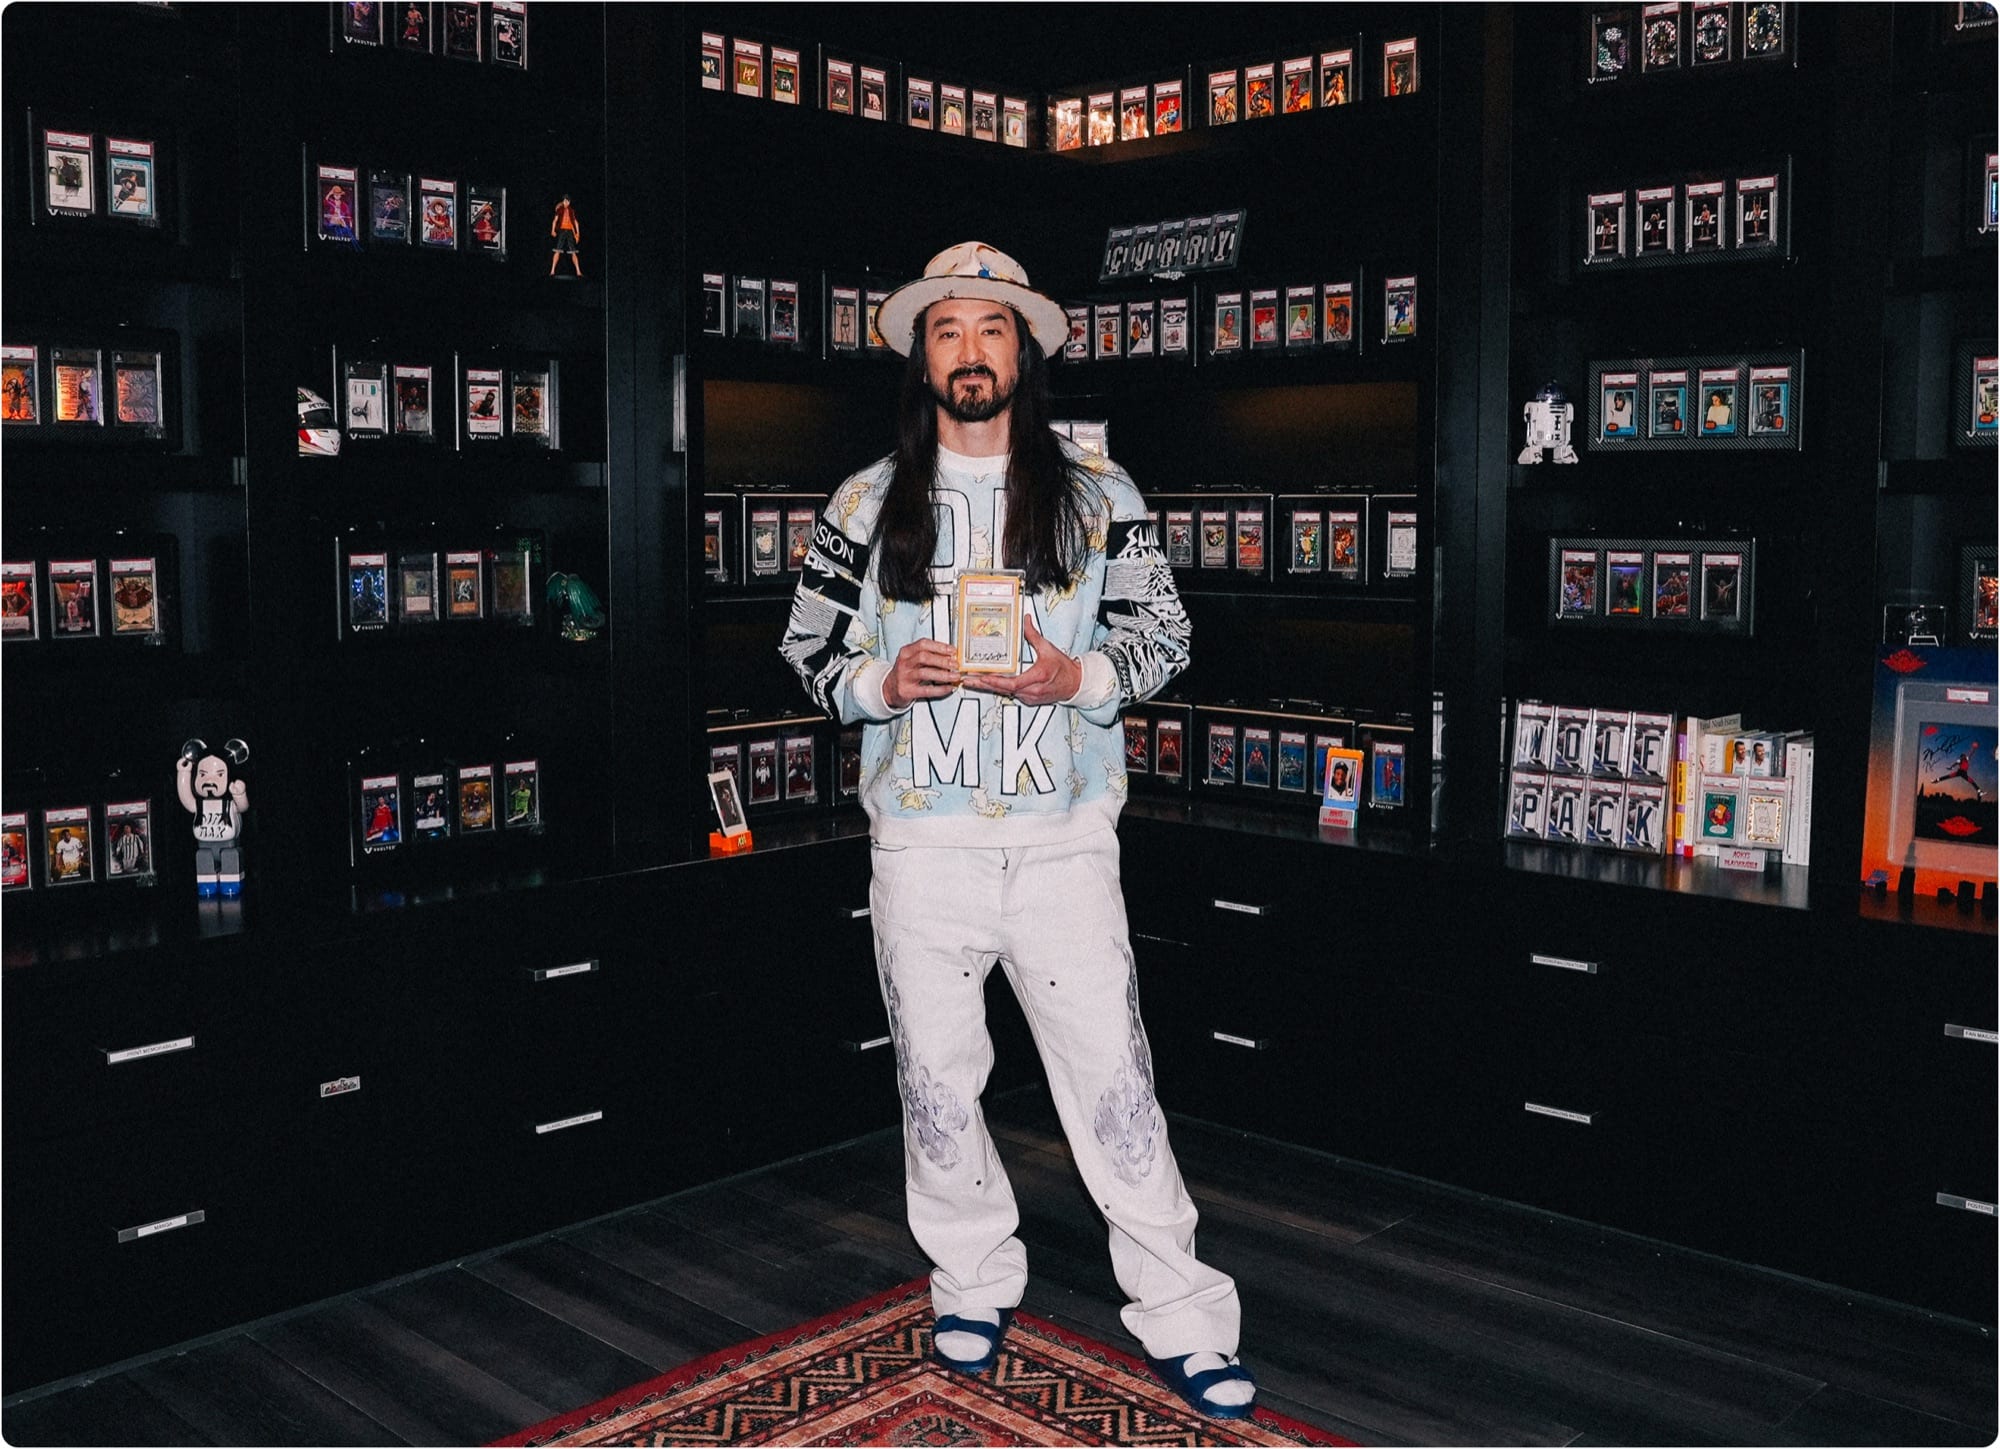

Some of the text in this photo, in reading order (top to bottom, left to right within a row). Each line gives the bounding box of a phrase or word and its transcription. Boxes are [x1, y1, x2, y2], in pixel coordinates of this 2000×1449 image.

[1965, 20, 1993, 29] VAULTED
[59, 210, 88, 218] VAULTED
[1693, 214, 1717, 226] UC
[1745, 209, 1768, 221] UC
[1595, 223, 1618, 235] UC
[1644, 219, 1666, 231] UC
[1108, 229, 1234, 274] CURRY
[911, 696, 1057, 795] MK
[1529, 724, 1662, 773] WOLF
[1520, 793, 1653, 843] PACK
